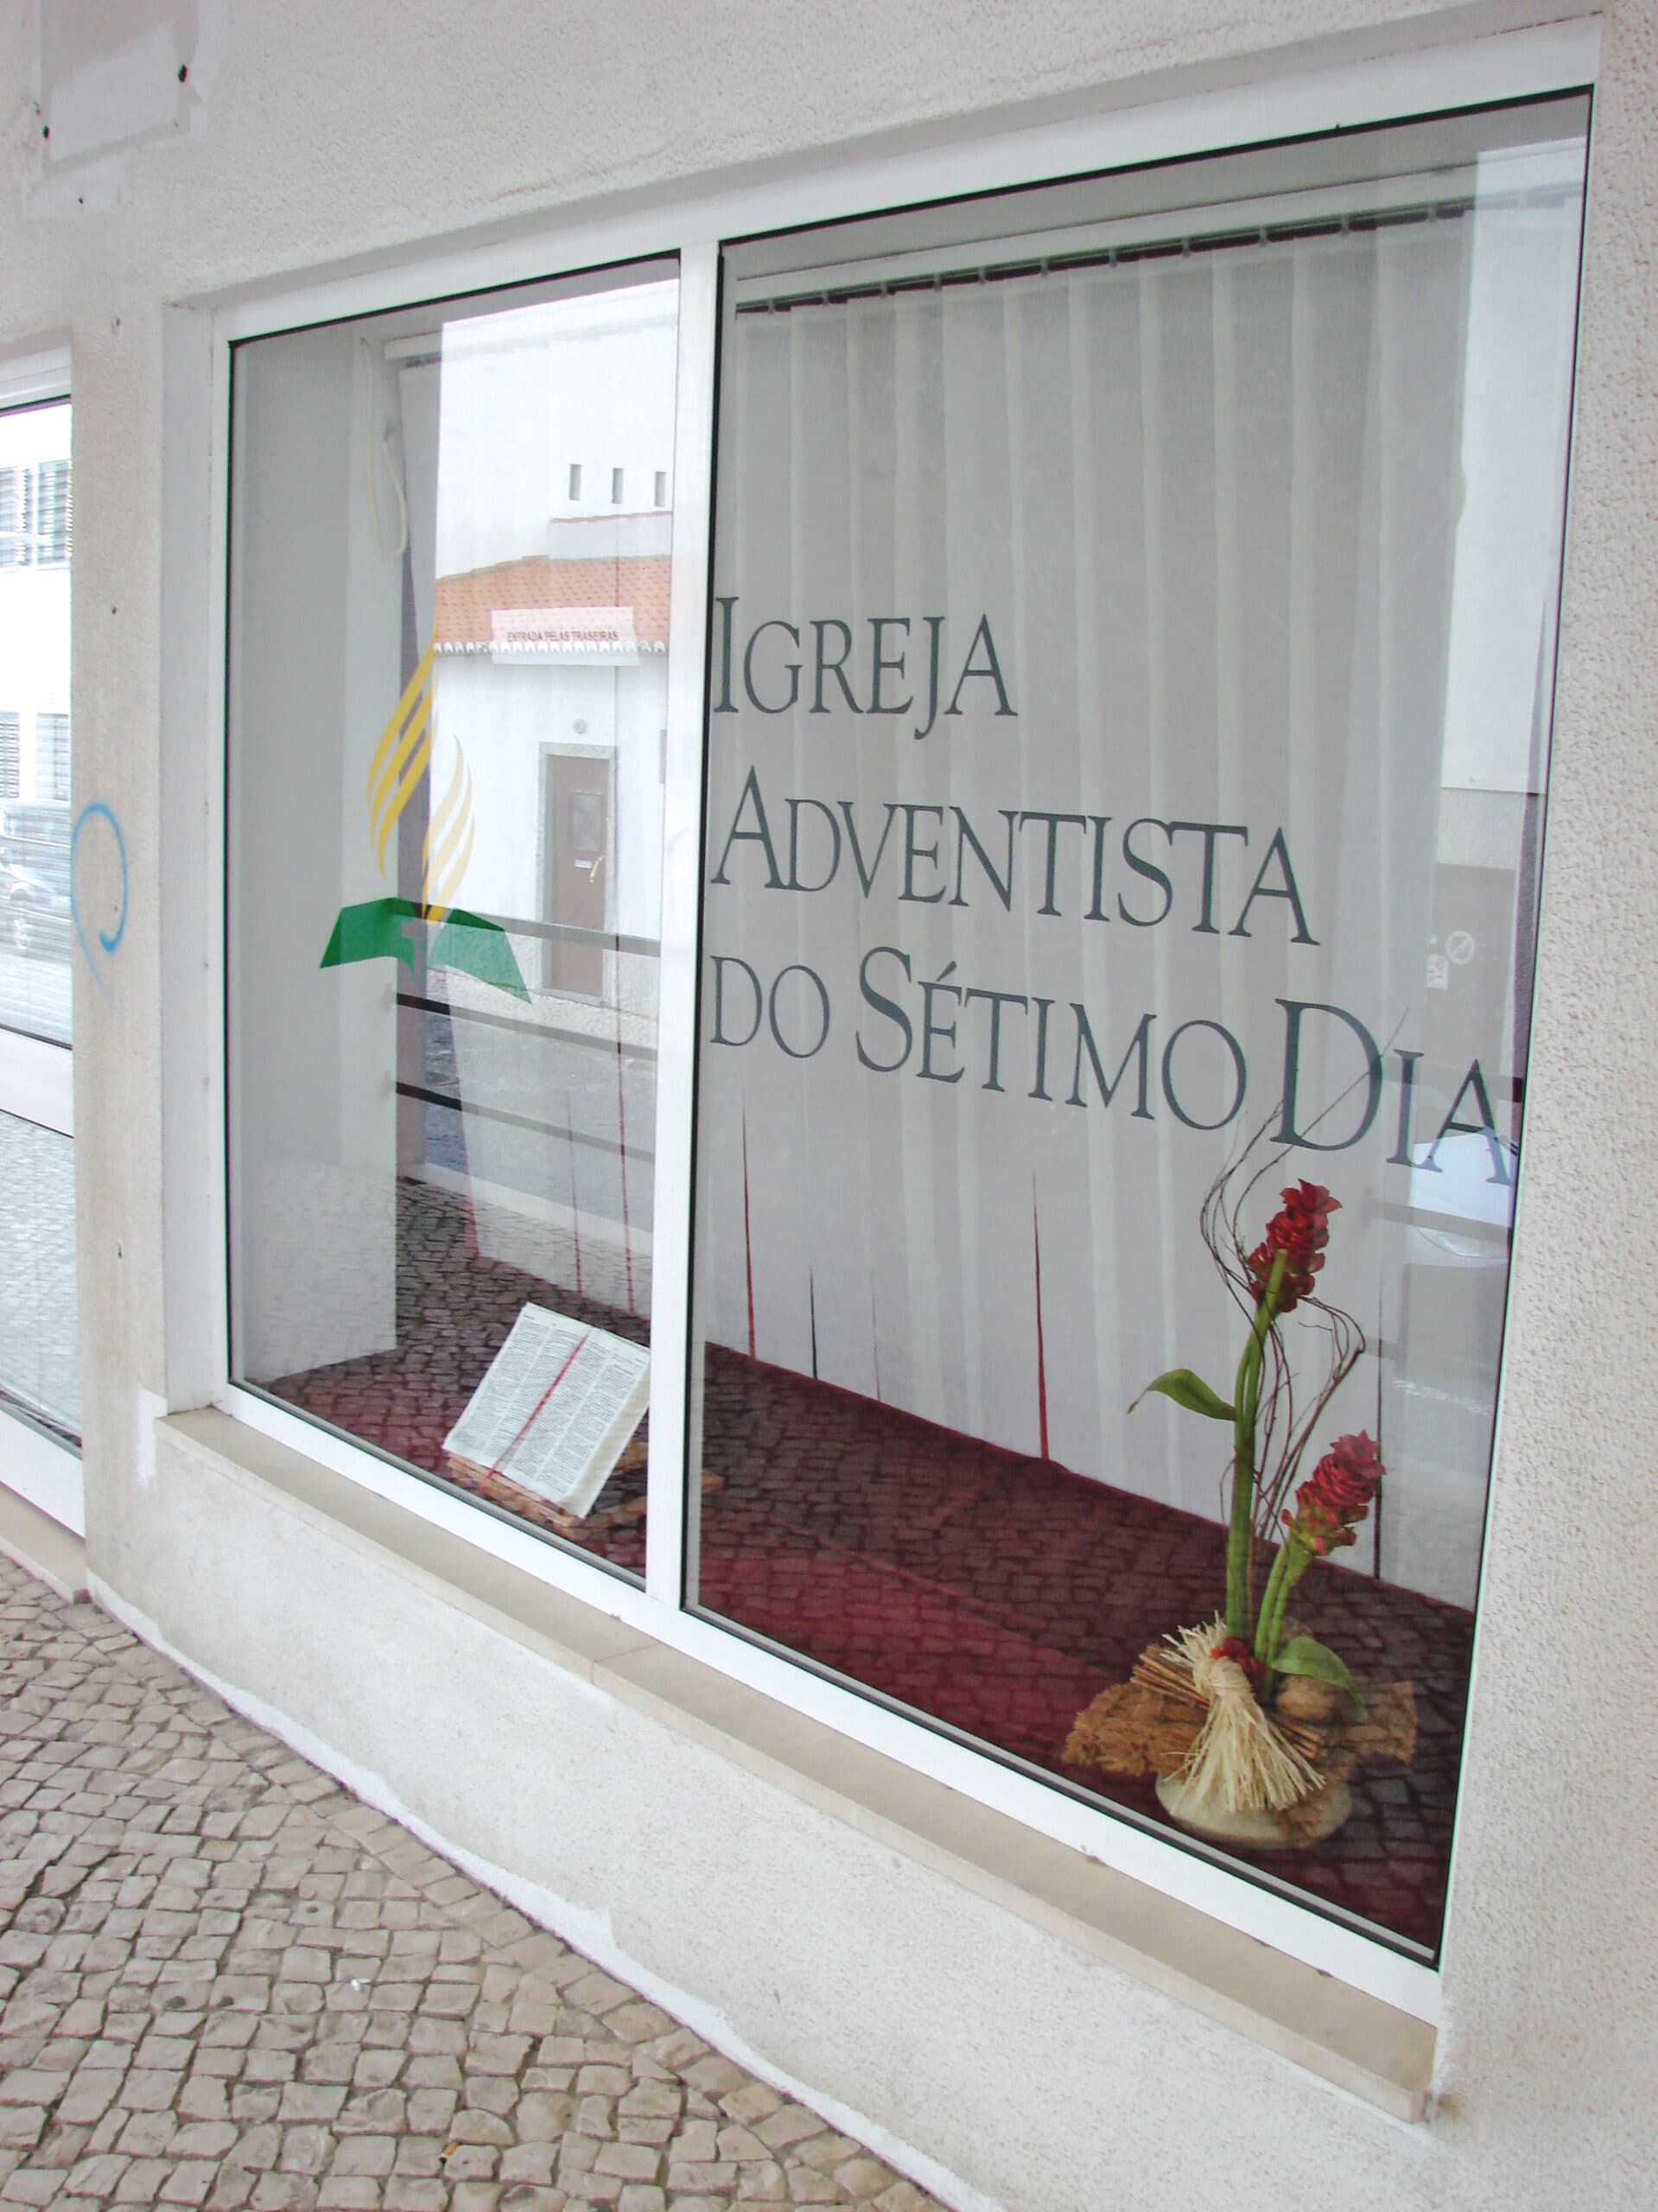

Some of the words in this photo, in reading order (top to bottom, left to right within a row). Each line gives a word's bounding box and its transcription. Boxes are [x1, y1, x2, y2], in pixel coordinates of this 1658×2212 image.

[507, 632, 543, 642] ENTRADA
[544, 632, 570, 641] PELAS
[714, 596, 1018, 740] IGREJA
[710, 766, 1320, 945] ADVENTISTA
[709, 956, 830, 1058] DO
[855, 946, 1247, 1130] SÉTIMO
[1269, 999, 1515, 1185] DIA
